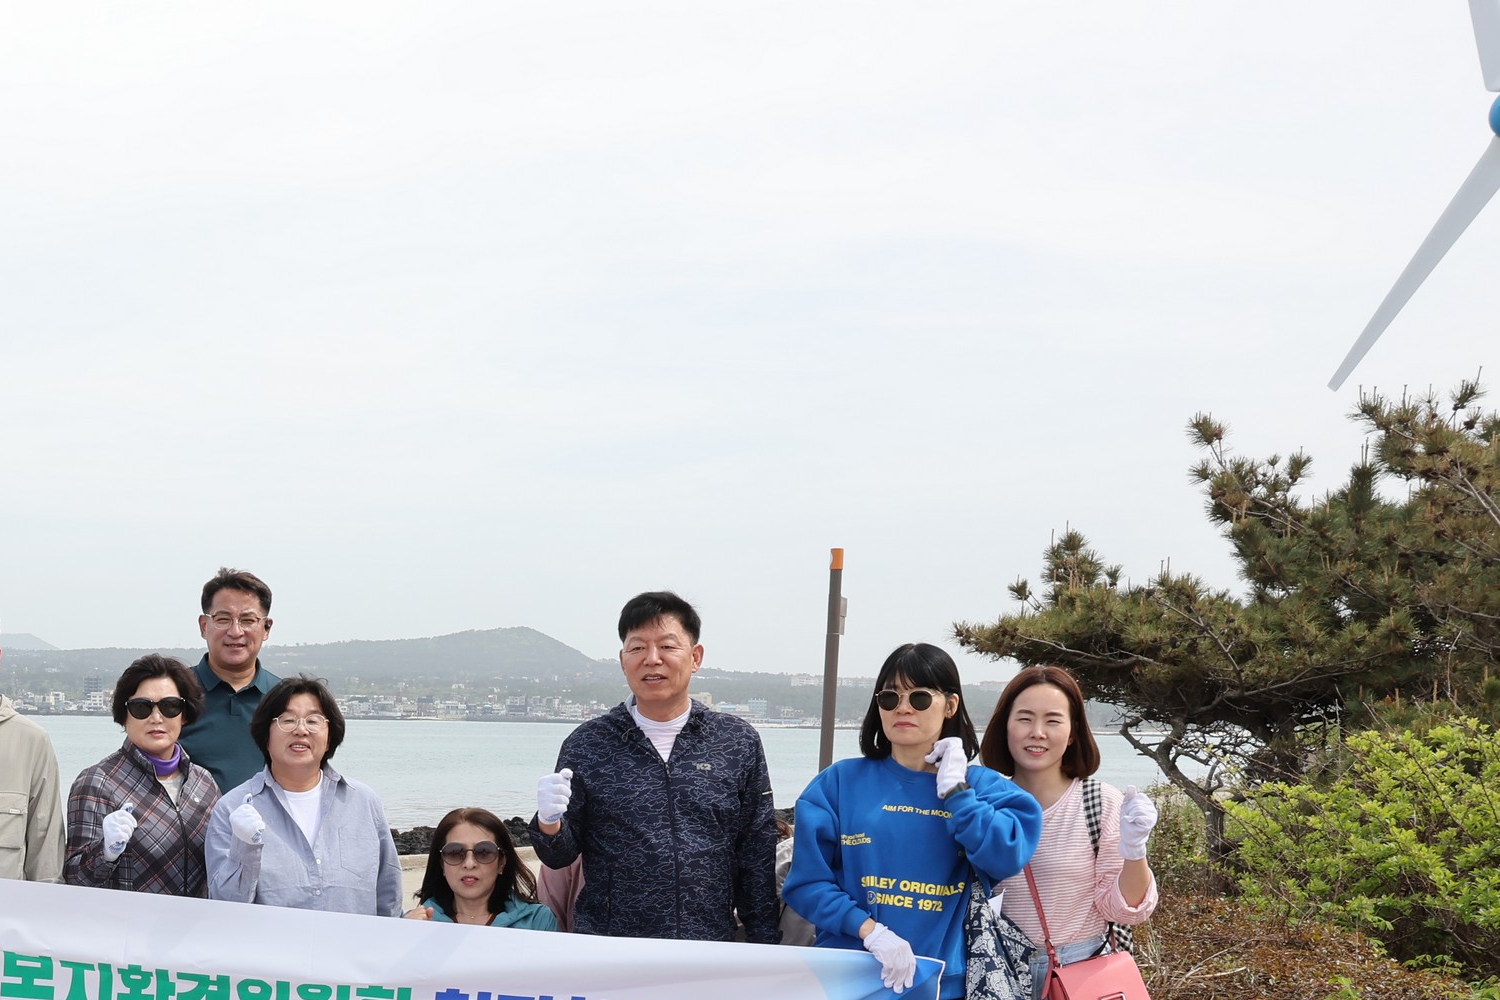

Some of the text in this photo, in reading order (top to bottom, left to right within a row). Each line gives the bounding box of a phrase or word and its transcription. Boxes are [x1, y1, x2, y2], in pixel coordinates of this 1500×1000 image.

[696, 763, 712, 771] K2
[882, 804, 897, 812] AIM
[897, 805, 914, 813] FOR
[915, 807, 931, 816] THE
[876, 892, 943, 912] SINCE 1972
